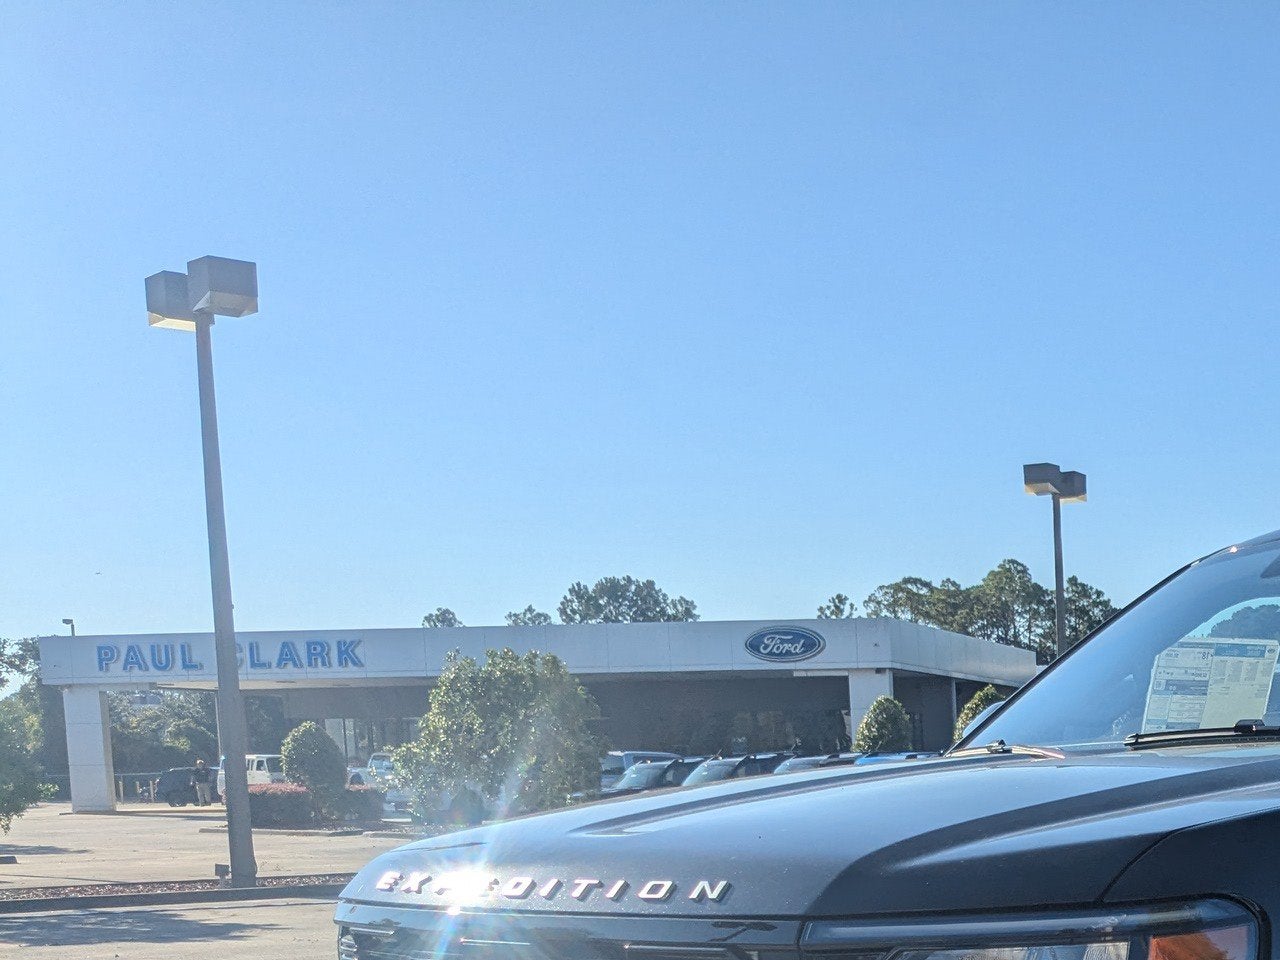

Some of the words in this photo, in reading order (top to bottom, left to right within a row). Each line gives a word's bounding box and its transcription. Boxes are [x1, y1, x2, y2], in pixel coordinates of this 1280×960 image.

[97, 643, 202, 671] PAUL
[760, 634, 805, 654] Ford
[375, 870, 733, 901] EXDITION
